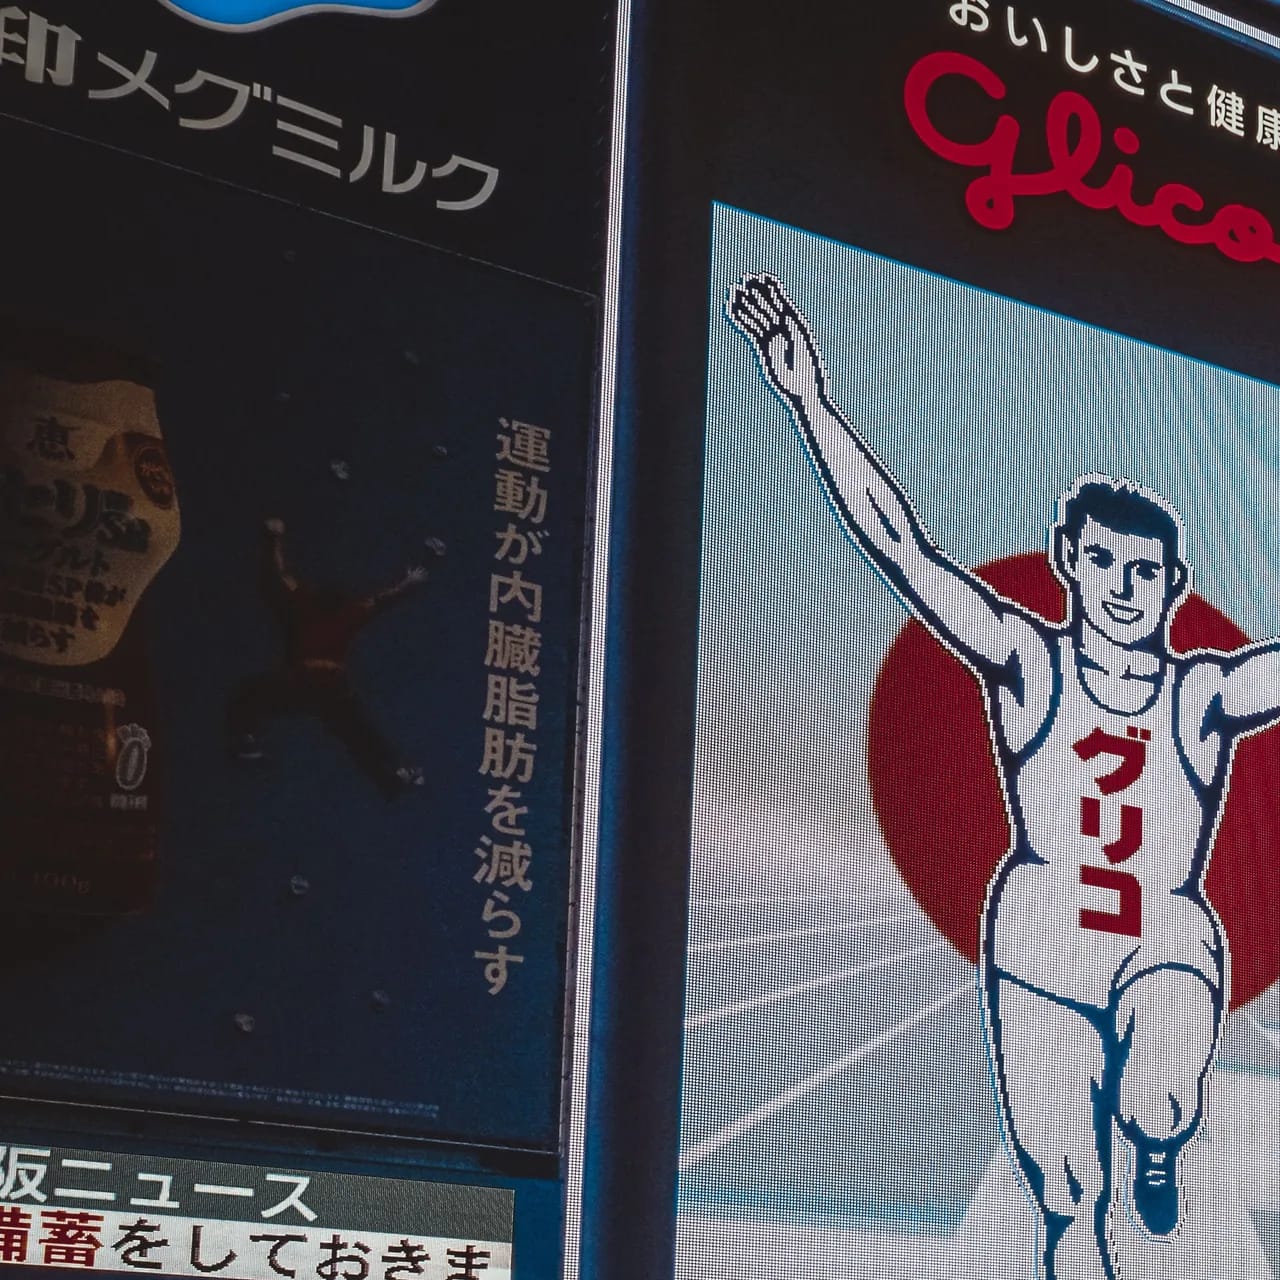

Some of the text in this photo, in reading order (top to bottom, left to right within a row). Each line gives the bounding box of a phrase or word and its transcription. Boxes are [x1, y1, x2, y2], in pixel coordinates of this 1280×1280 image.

[473, 416, 551, 996] 運動が内臓脂肪を減らす
[1072, 725, 1151, 938] グリコ
